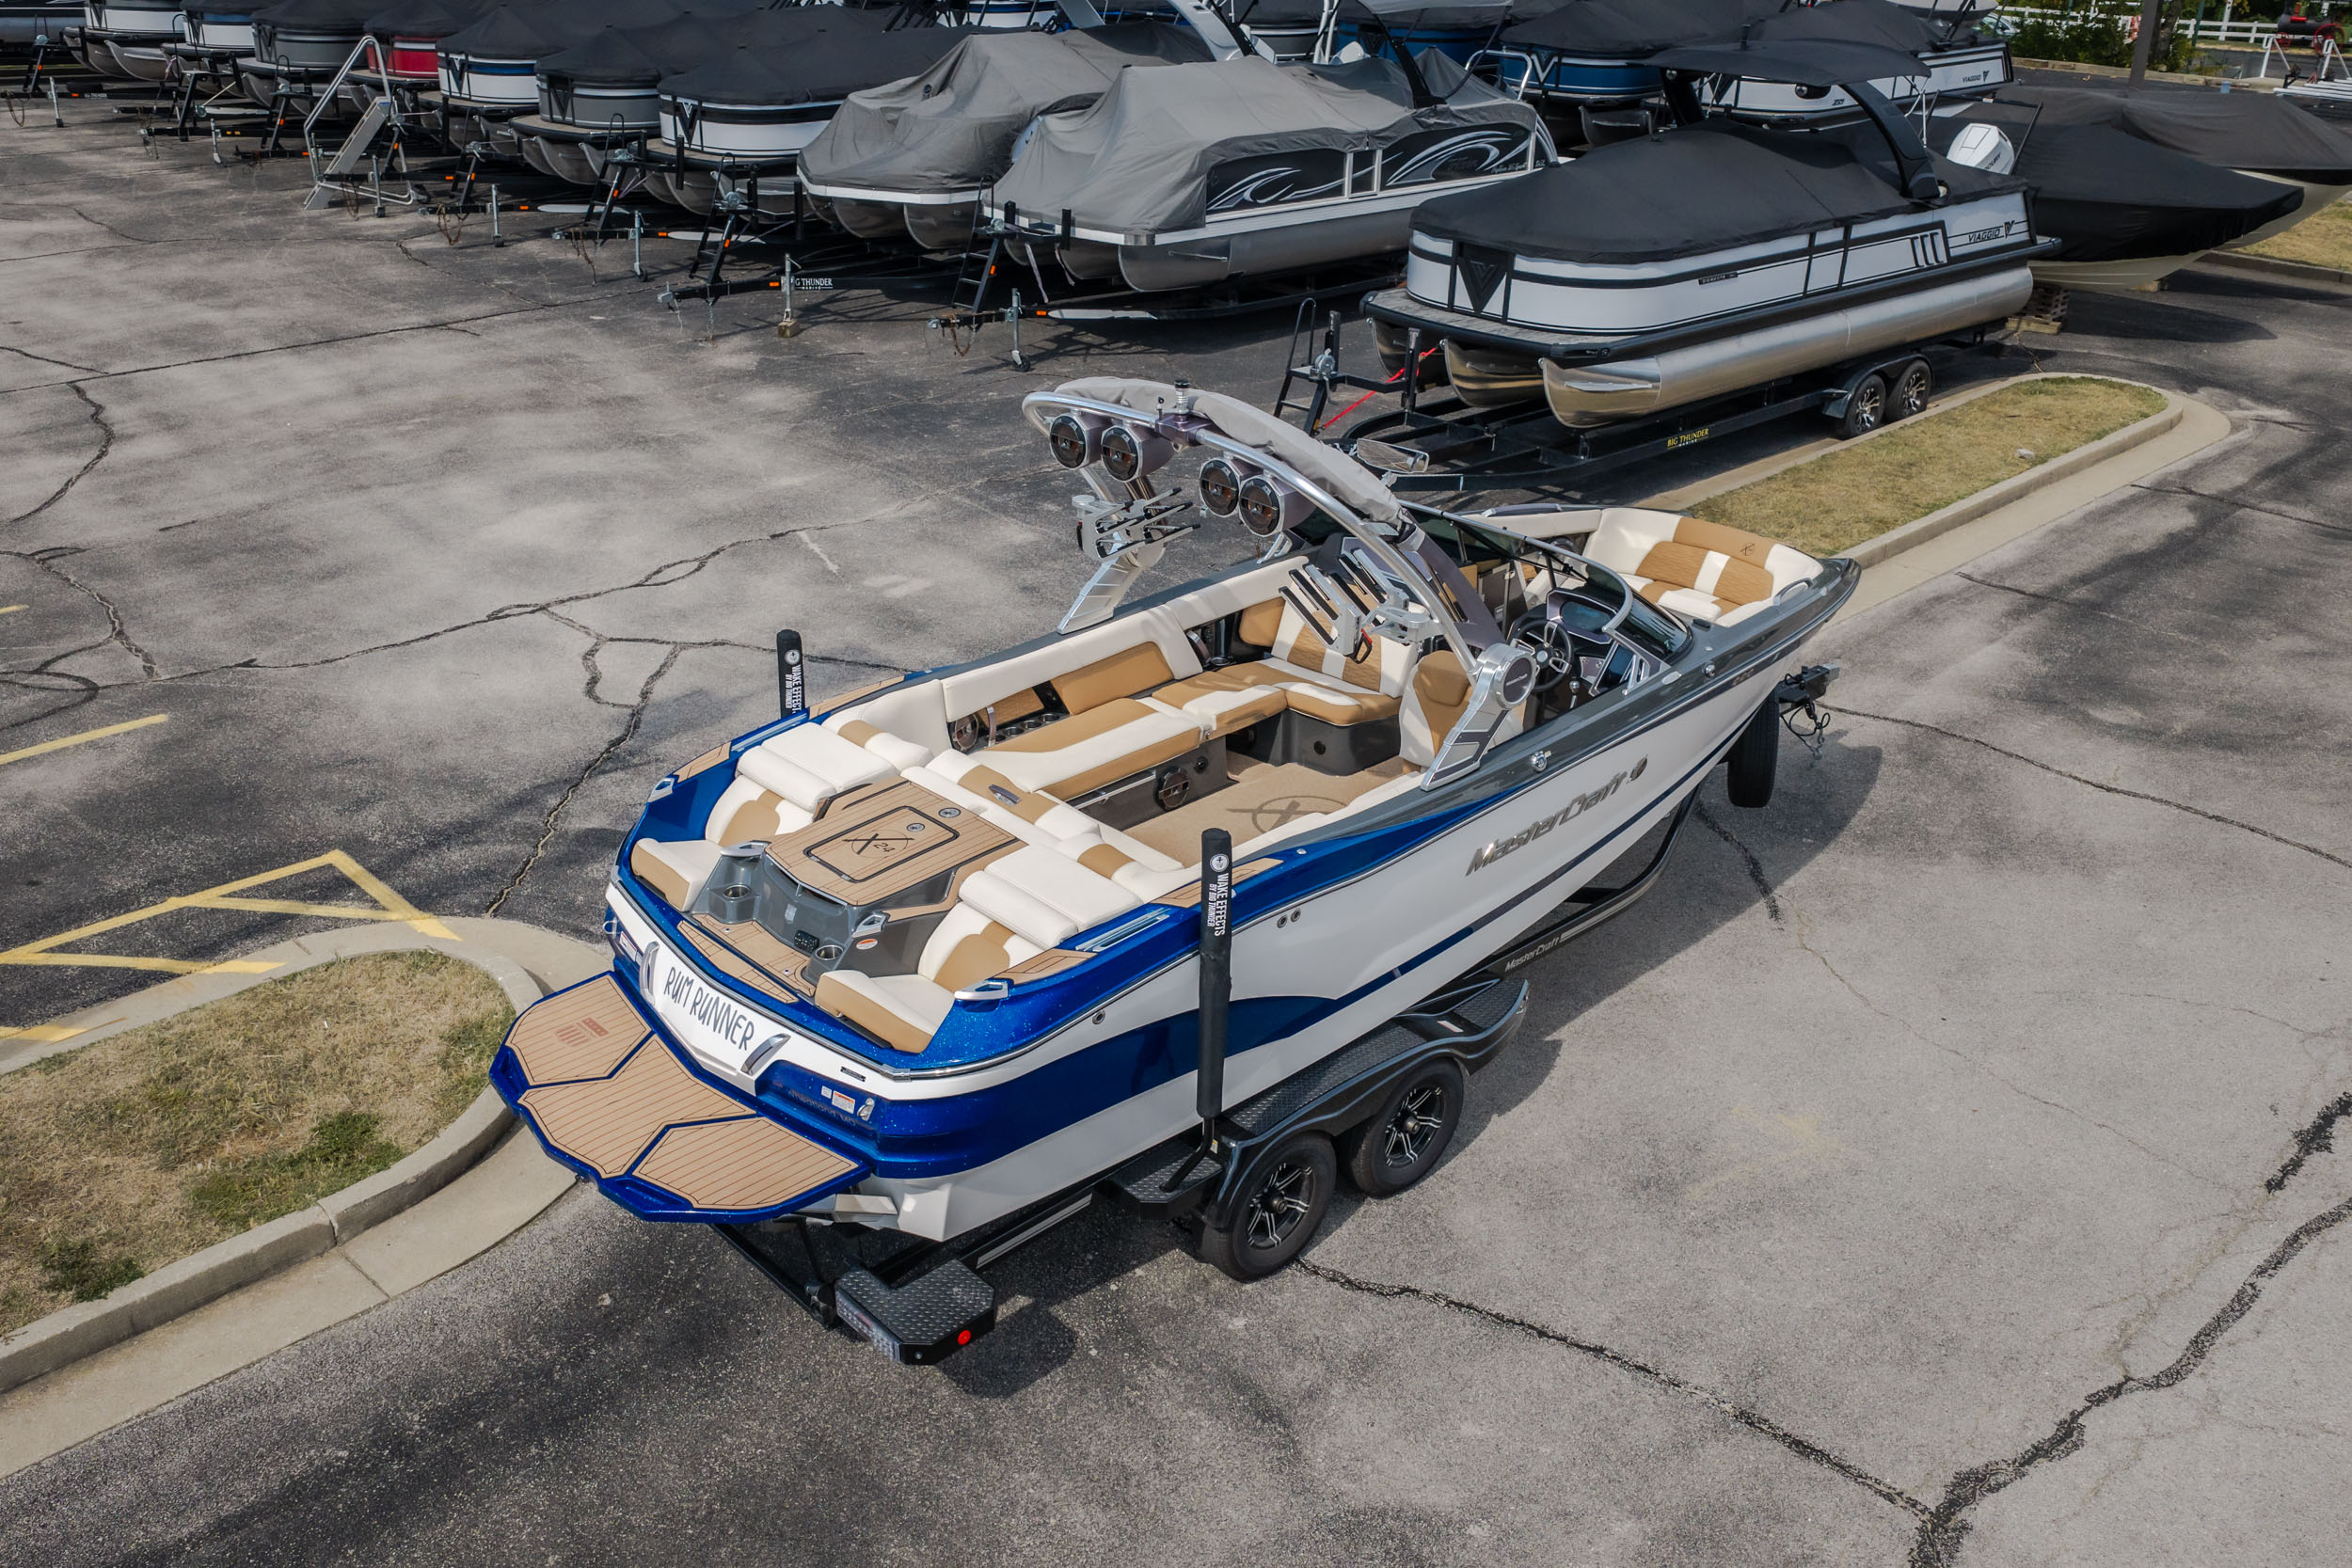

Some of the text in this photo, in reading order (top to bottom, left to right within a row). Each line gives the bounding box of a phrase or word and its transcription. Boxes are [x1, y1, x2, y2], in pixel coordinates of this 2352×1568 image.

[1968, 229, 2001, 243] VIAGGIO
[801, 277, 834, 286] THUNDER
[1667, 436, 1678, 447] BIG
[1679, 428, 1709, 443] THUNDER
[792, 664, 802, 686] WAKE
[1465, 770, 1629, 878] MasterCraft
[1207, 902, 1216, 927] THUNDER
[1215, 873, 1229, 936] WAKE EFFECTS
[1505, 936, 1560, 973] MasterCraft
[663, 966, 755, 1051] RUM RUNNER
